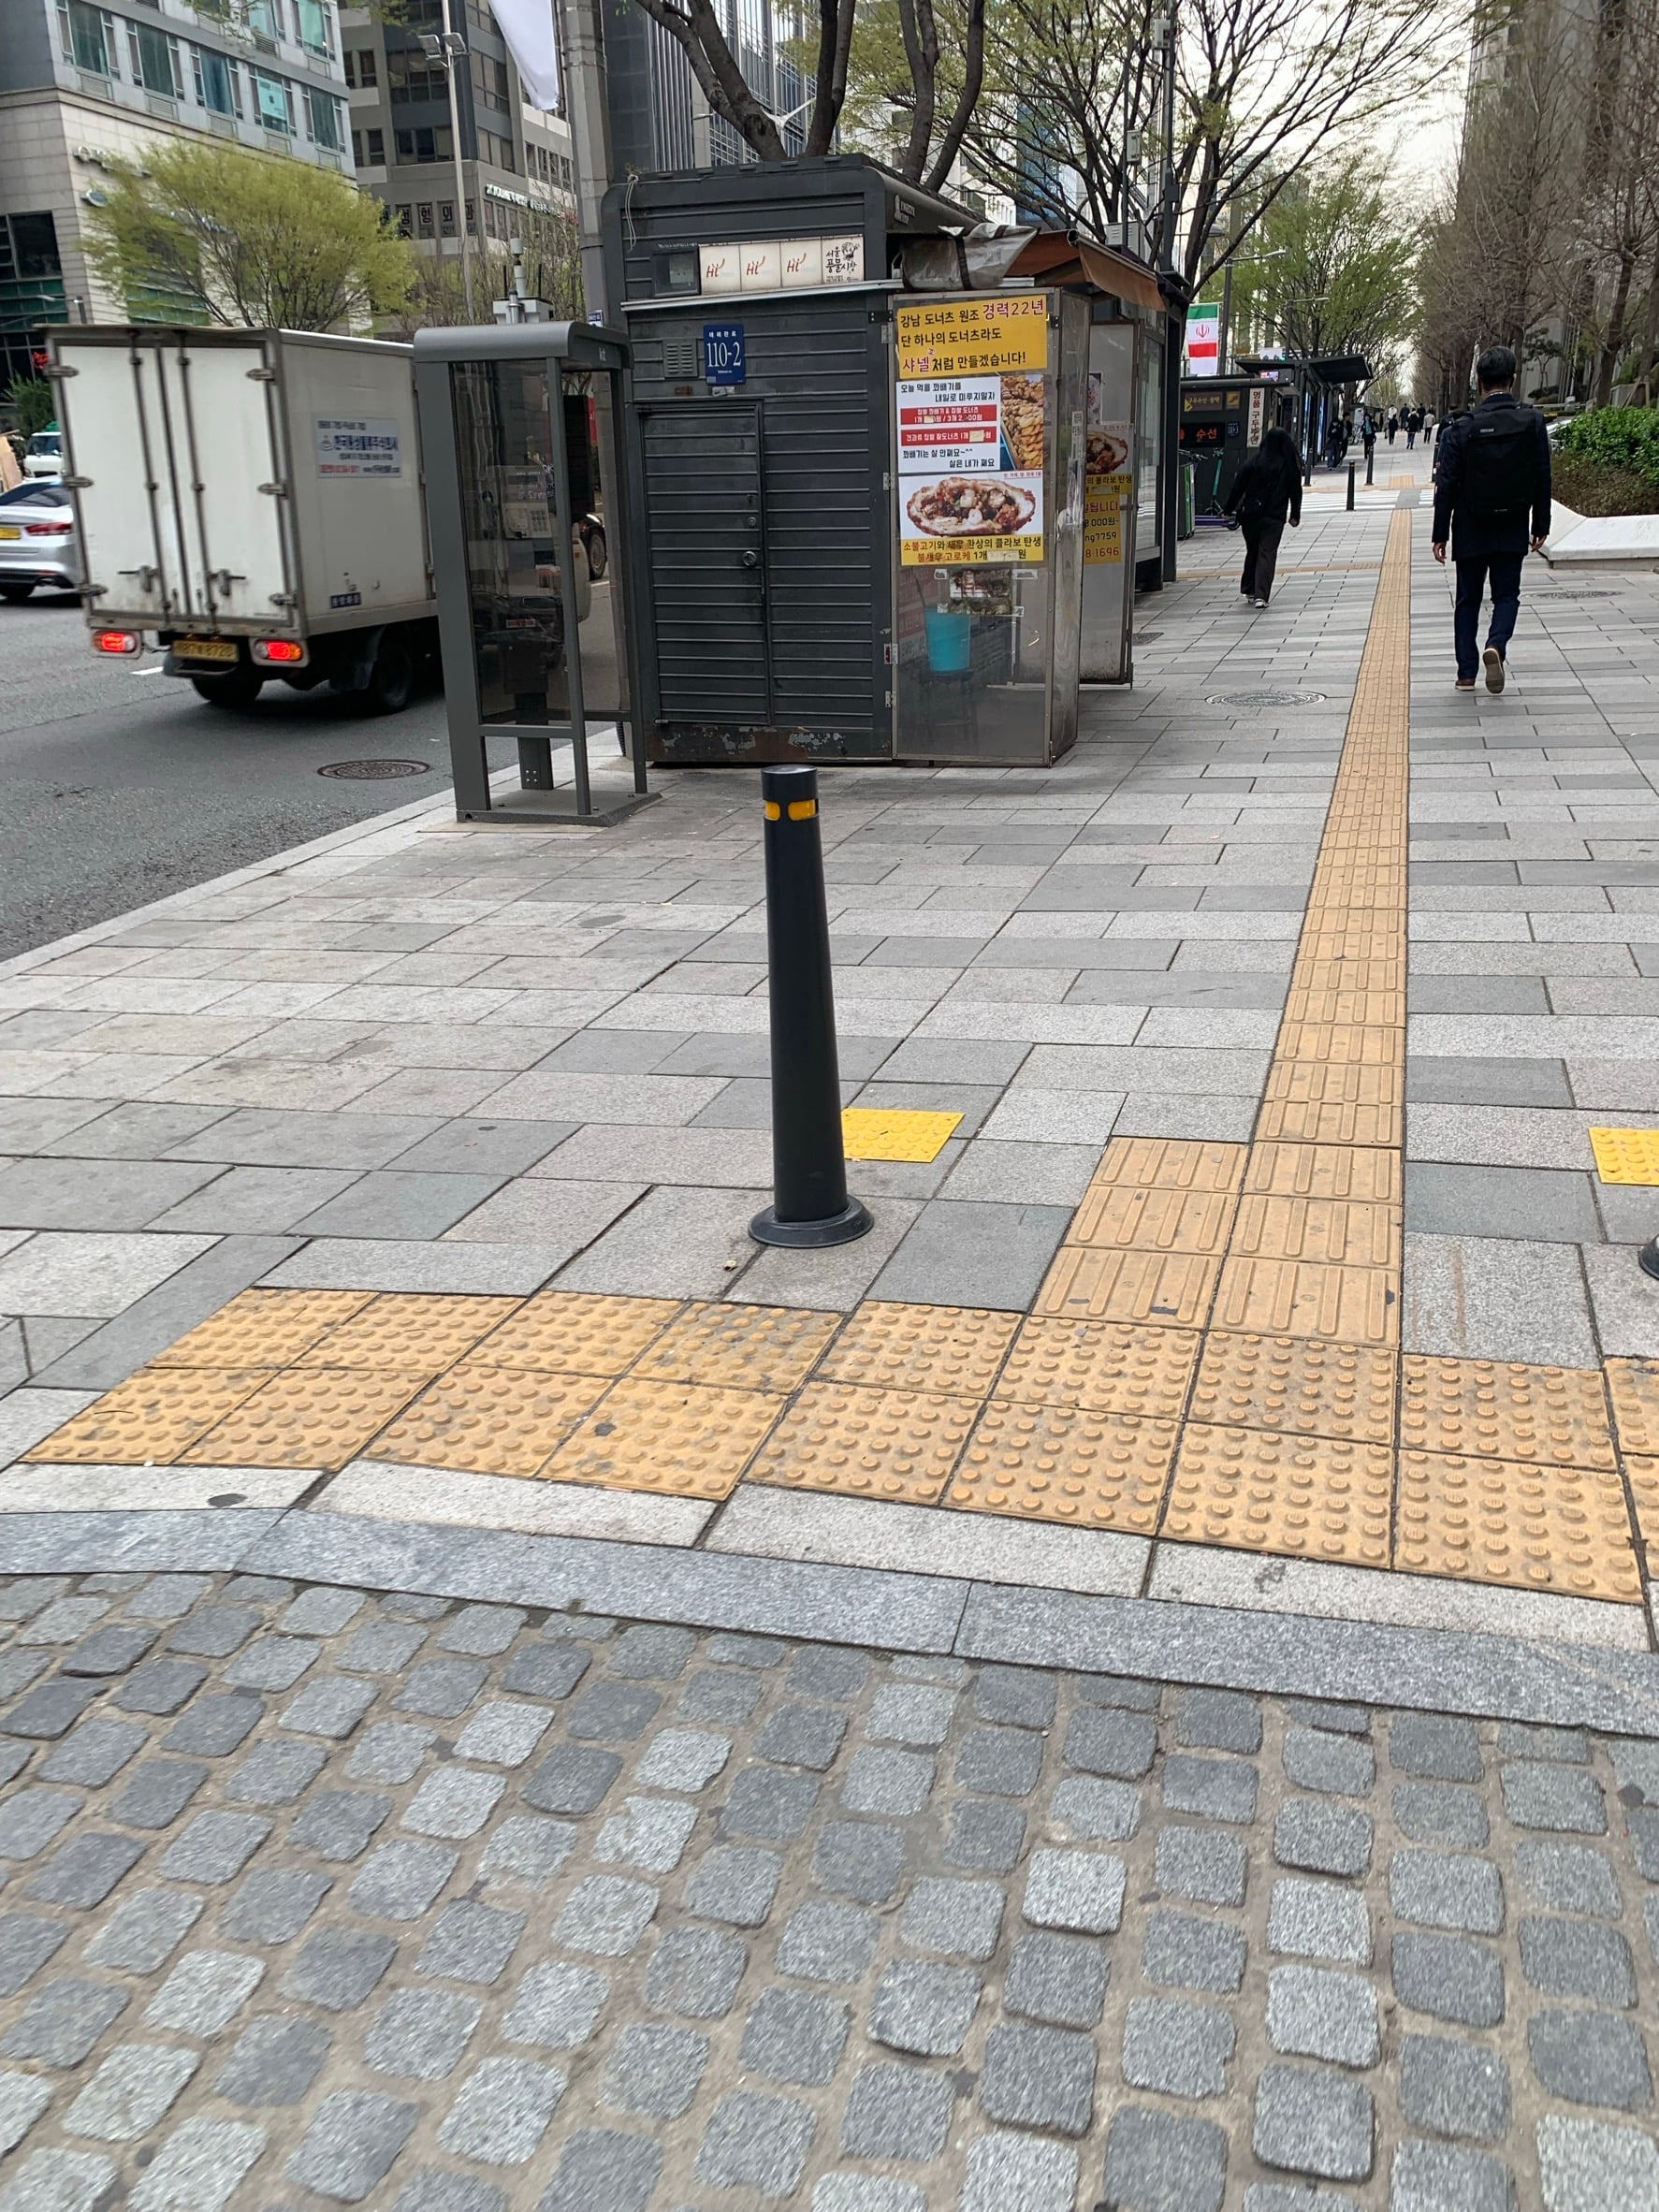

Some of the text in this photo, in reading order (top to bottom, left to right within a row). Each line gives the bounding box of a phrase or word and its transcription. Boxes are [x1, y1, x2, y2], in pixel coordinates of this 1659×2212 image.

[826, 246, 841, 258] 서울
[706, 261, 721, 278] Hi
[746, 259, 762, 276] Hi
[787, 256, 802, 273] Hi
[825, 258, 857, 273] 풍물시장
[900, 298, 1044, 328] 강남 도너츠 원조 경력22년
[901, 327, 1002, 348] 단 하나의 도너츠라도
[706, 342, 742, 368] 110-2
[957, 351, 1026, 370] 만들겠습니다!
[901, 384, 915, 393] 오늘
[935, 391, 996, 402] 내일로 미루지말자
[1197, 429, 1217, 440] 수선
[903, 449, 929, 458] 꽈배기는
[931, 449, 938, 458] 살
[949, 459, 963, 468] 살은
[965, 458, 979, 468] 내가
[1118, 474, 1132, 484] 탄생
[903, 540, 945, 551] 소불고기와
[996, 537, 1022, 548] 콜라보
[1024, 536, 1041, 547] 탄생
[974, 550, 988, 560] 1개
[1096, 546, 1119, 558] 1696
